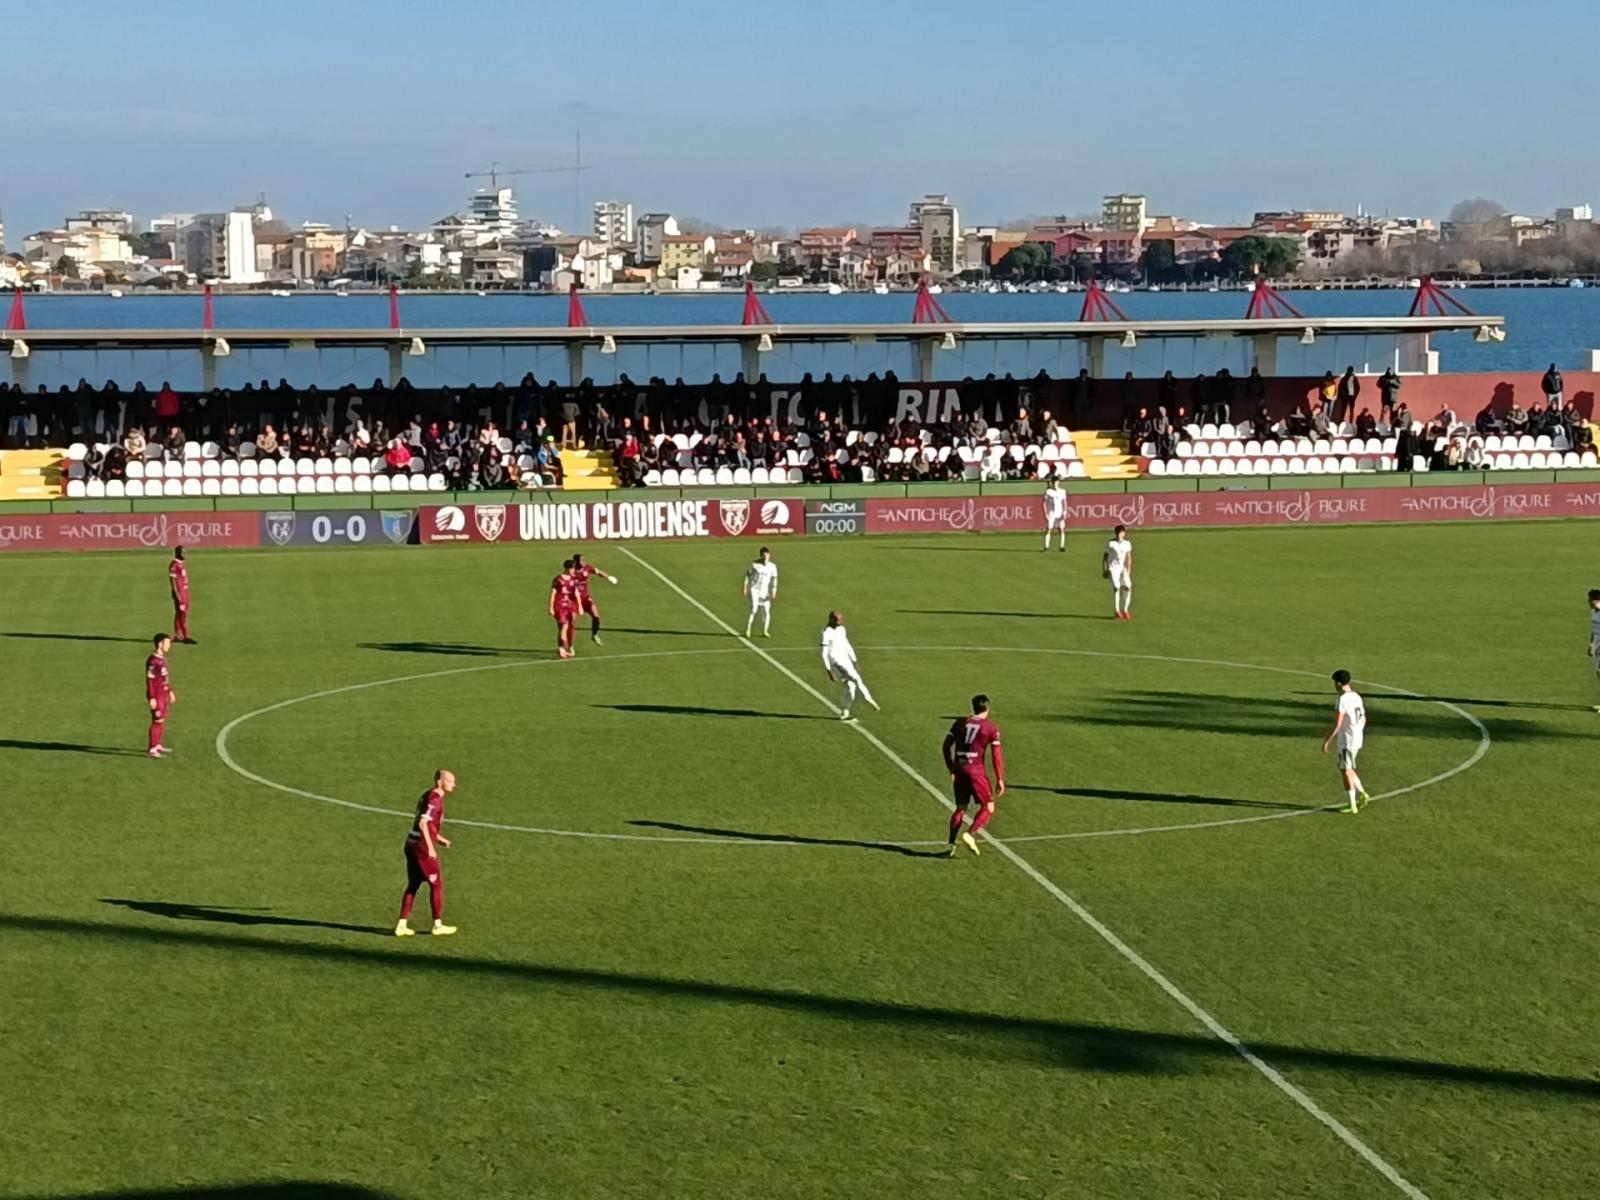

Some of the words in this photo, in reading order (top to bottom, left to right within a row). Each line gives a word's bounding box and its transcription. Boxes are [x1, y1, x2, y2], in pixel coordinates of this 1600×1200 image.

[1319, 499, 1366, 513] FIGURE
[1503, 493, 1551, 508] FIGURE
[983, 506, 1033, 521] FIGURE
[1067, 503, 1121, 518] NTICHE
[1152, 502, 1201, 516] FIGURE
[519, 503, 587, 540] UNION
[593, 501, 709, 539] CLODIENSE
[815, 519, 856, 533] 00:00
[177, 522, 233, 537] FIGURE
[312, 515, 367, 543] 0-0
[965, 723, 981, 744] 17
